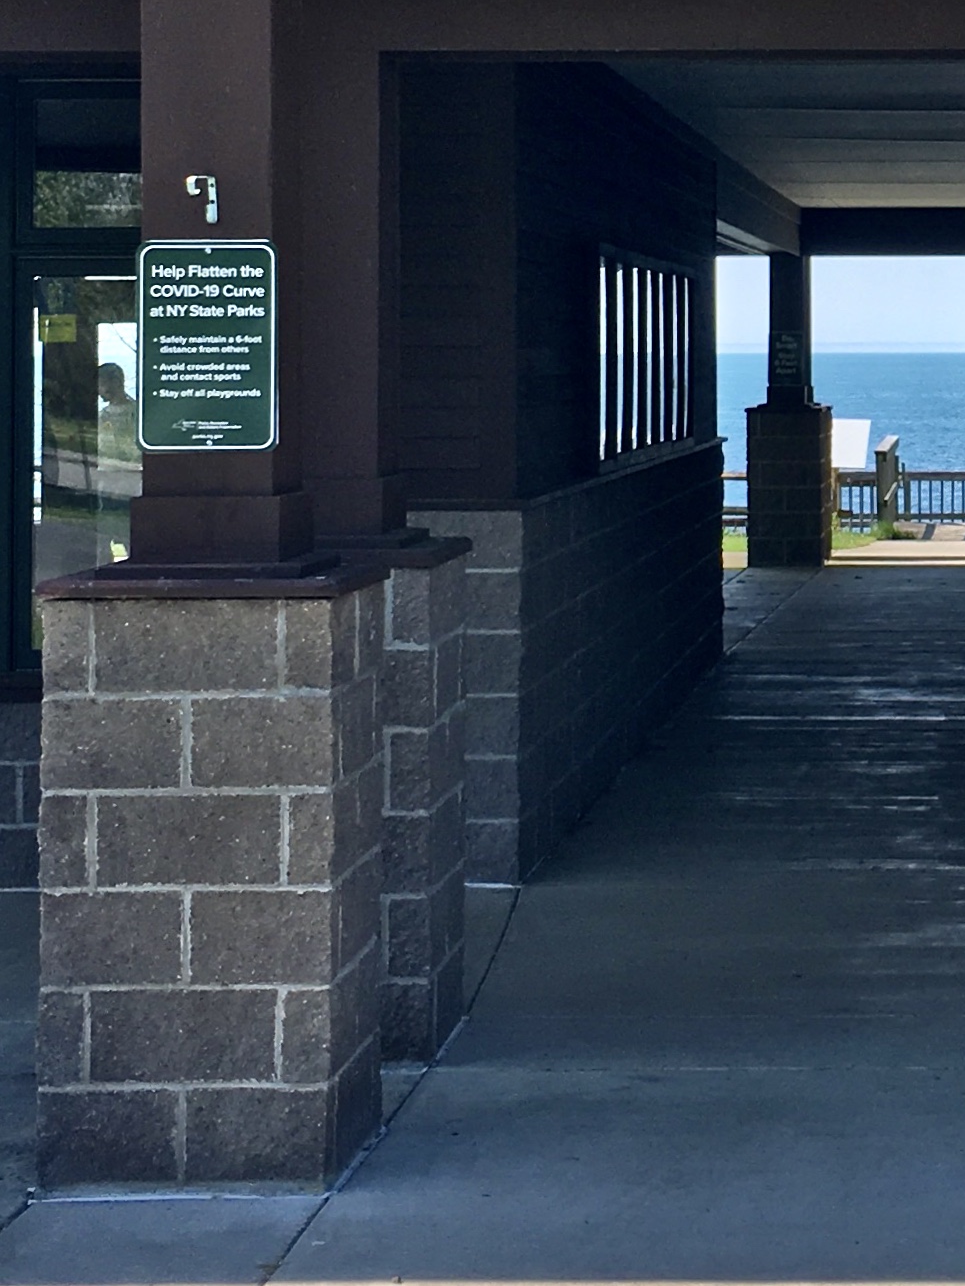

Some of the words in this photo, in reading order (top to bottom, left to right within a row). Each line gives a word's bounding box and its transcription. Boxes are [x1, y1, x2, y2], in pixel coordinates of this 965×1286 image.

[151, 265, 185, 280] Help
[188, 265, 237, 277] Flatten
[240, 265, 264, 277] the
[150, 285, 219, 297] COVID-19
[223, 285, 265, 297] Curve
[150, 306, 163, 317] at
[166, 305, 188, 316] NY
[189, 305, 224, 317] State
[228, 305, 265, 317] Parks
[160, 336, 187, 345] Safely
[189, 336, 226, 344] maintain
[236, 336, 262, 344] 6-foot
[160, 345, 197, 354] distance
[199, 345, 219, 354] from
[221, 346, 249, 354] others
[160, 363, 185, 371] Avoid
[187, 363, 224, 371] crowded
[161, 373, 178, 381] and
[180, 373, 212, 381] contact
[214, 373, 241, 382] sports
[159, 389, 179, 399] Stay
[181, 389, 193, 397] off
[195, 389, 205, 397] all
[207, 389, 261, 399] playgrounds
